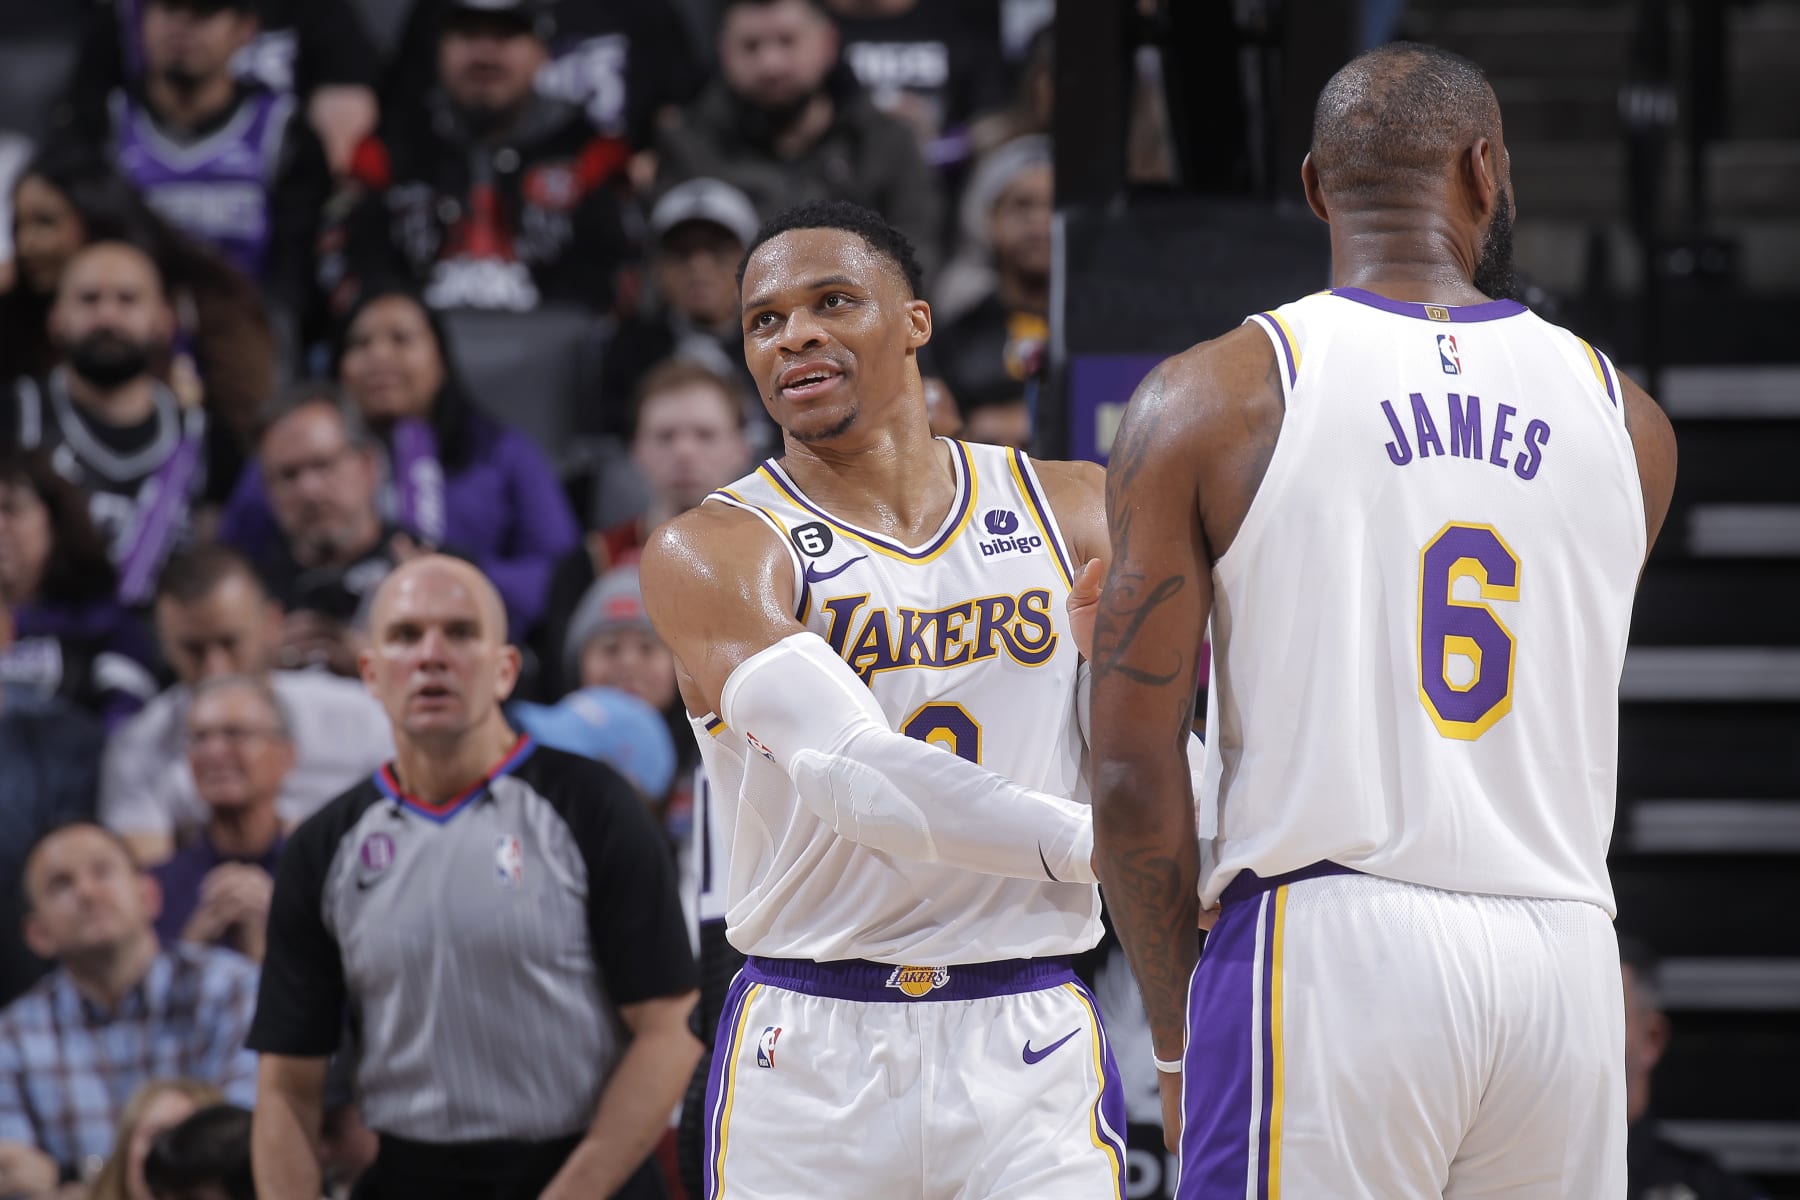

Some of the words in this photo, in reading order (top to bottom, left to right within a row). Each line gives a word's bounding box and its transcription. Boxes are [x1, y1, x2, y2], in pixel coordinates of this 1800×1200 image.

[1381, 393, 1550, 480] JAMES
[797, 527, 825, 553] 6
[979, 536, 1041, 556] bibigo
[821, 587, 1059, 688] LAKERS
[1417, 519, 1522, 741] 6
[885, 966, 948, 987] LAKERS
